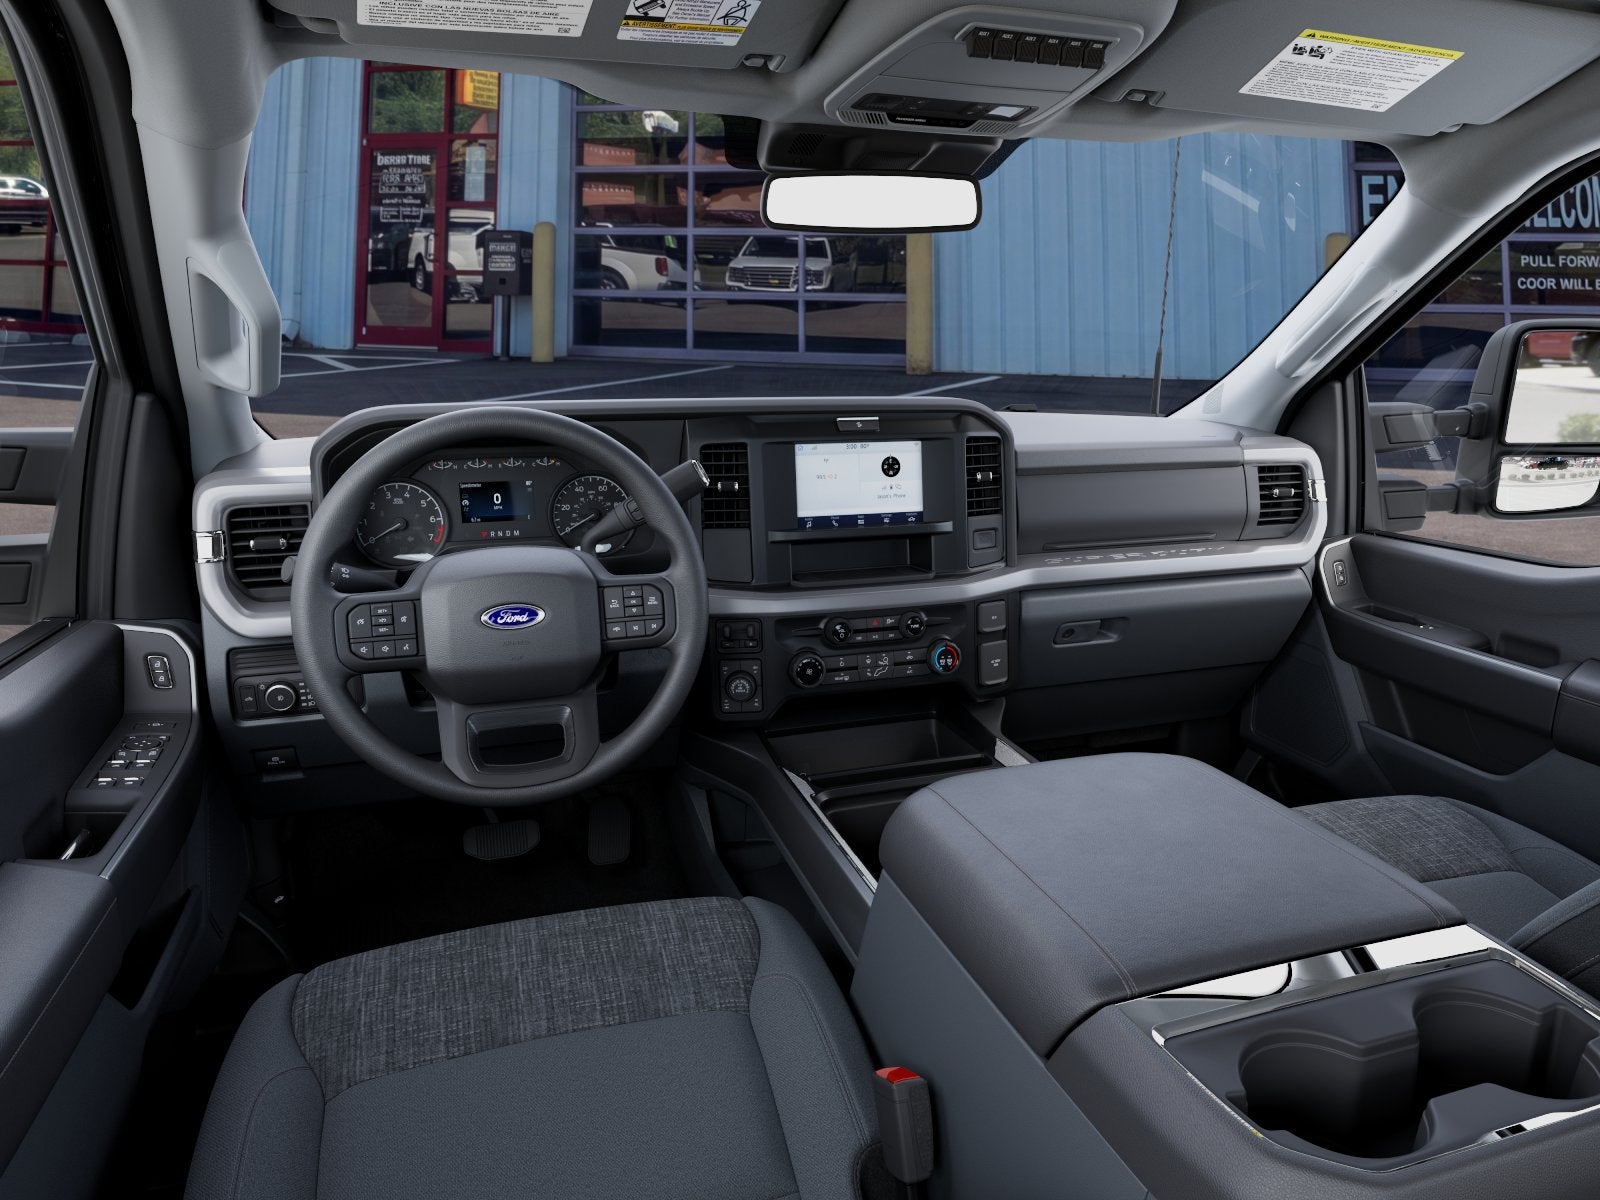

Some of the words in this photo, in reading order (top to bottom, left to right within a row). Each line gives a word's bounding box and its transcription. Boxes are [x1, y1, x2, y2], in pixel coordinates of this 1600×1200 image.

[1520, 255, 1556, 267] PULL
[1517, 277, 1557, 290] COOR
[1560, 278, 1593, 290] WILL
[494, 493, 501, 504] 0
[497, 609, 529, 623] Ford
